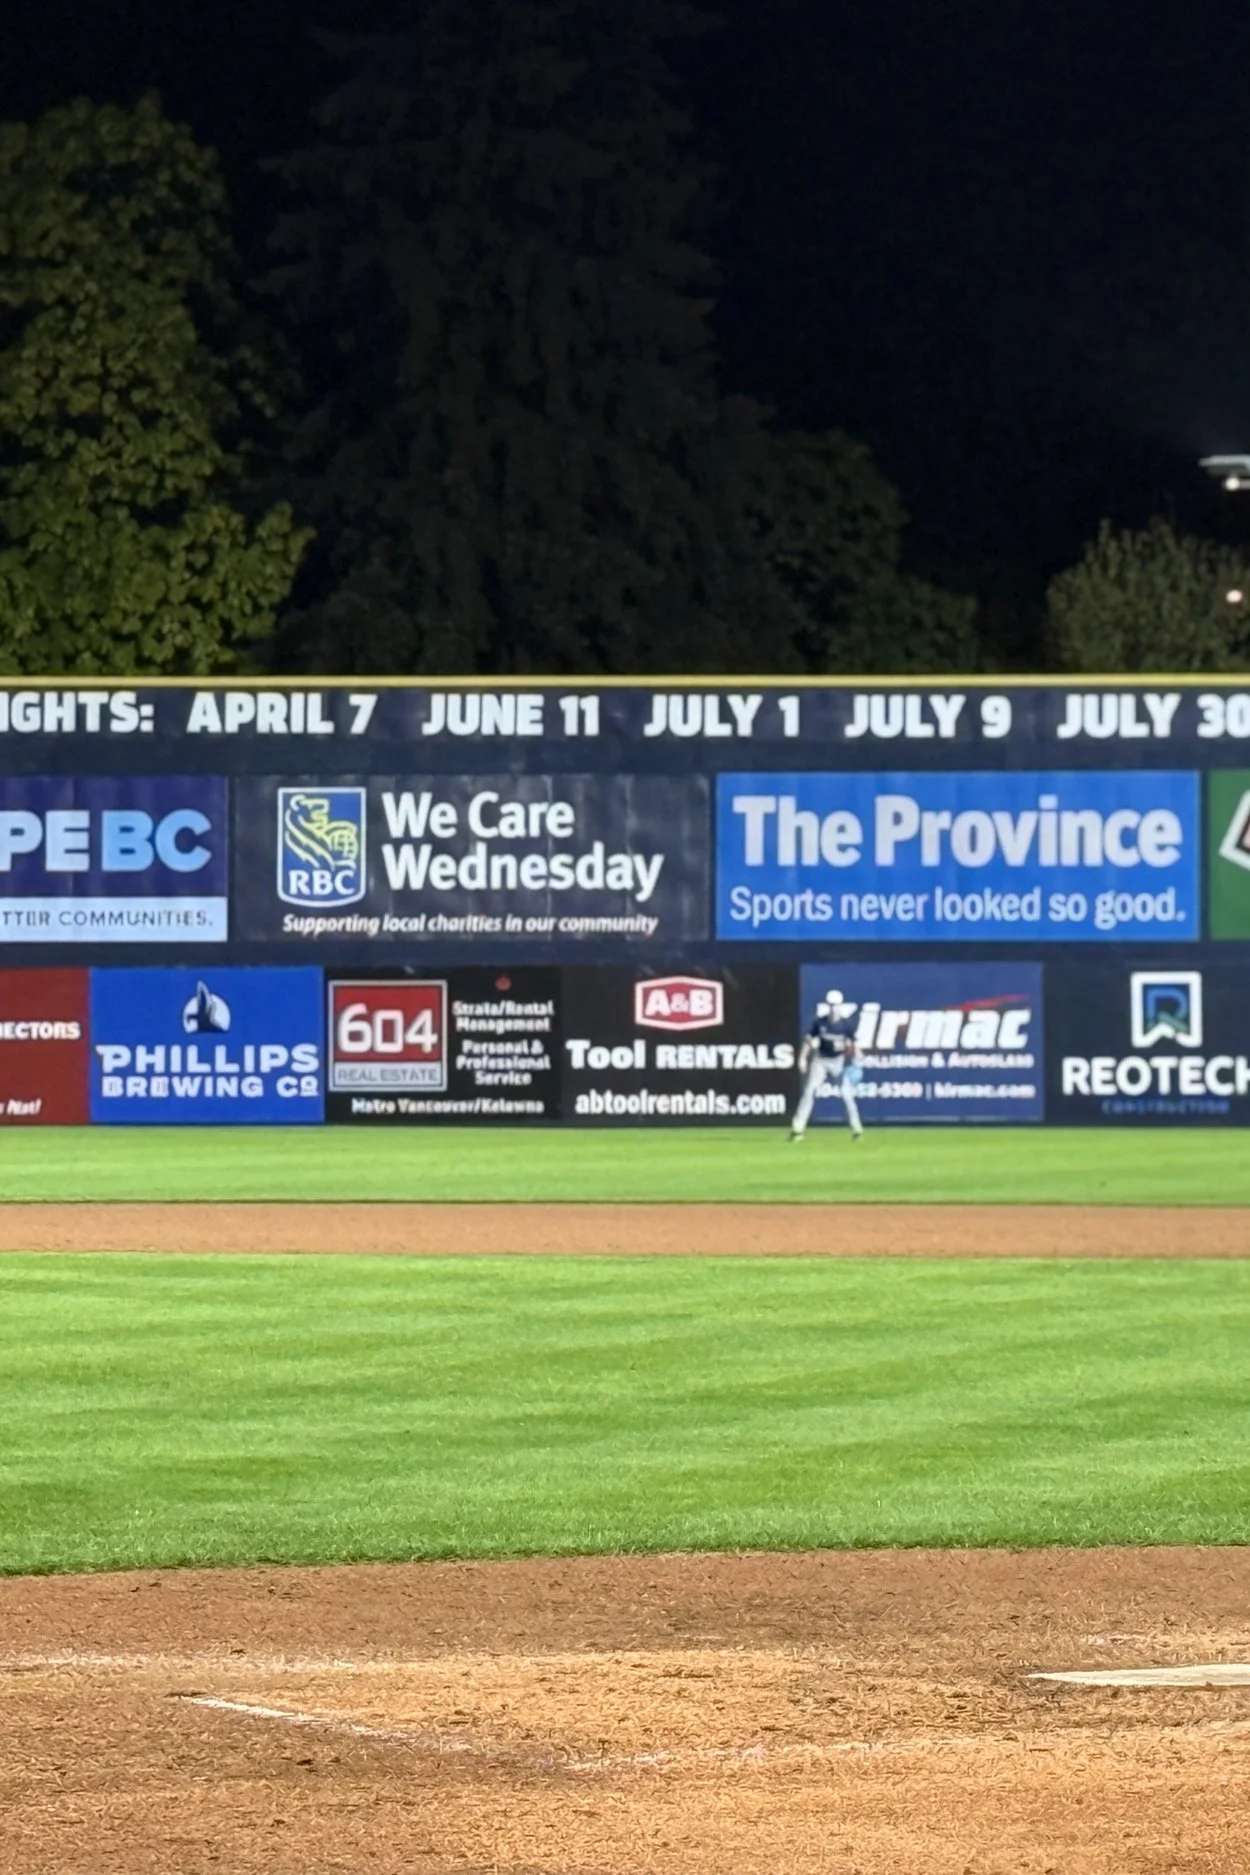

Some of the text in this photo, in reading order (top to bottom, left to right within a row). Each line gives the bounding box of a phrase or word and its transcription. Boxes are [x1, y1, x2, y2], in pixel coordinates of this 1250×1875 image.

[187, 691, 334, 734] APRIL
[350, 694, 378, 735] 7
[422, 695, 543, 736] JUNE
[560, 695, 600, 735] 11
[644, 694, 762, 737] JULY
[777, 695, 799, 736] 1
[845, 694, 965, 738] JULY
[981, 695, 1012, 738] 9
[1057, 693, 1181, 738] JULY
[381, 791, 574, 838] We Care
[102, 808, 212, 872] BC
[732, 794, 1183, 868] The Province
[288, 869, 356, 895] RBC
[381, 842, 664, 902] Wednesday
[58, 910, 214, 927] COMMUNITIES.
[730, 886, 1186, 930] Sports never looked so good.
[282, 914, 659, 937] Supporting local charities in our community
[645, 989, 714, 1016] A&B
[0, 1021, 80, 1039] ECTORS
[338, 1003, 438, 1053] 604
[456, 1017, 551, 1034] Management
[95, 1043, 319, 1073] PHILLIPS
[456, 1054, 551, 1070] Professional
[565, 1039, 795, 1069] Tool RENTALS
[931, 1052, 946, 1068] &
[102, 1076, 263, 1097] BREWING
[338, 1068, 439, 1082] REAL ESTATE
[475, 1070, 532, 1086] Service
[352, 1098, 395, 1114] Metro
[575, 1089, 786, 1114] abtoolrentals.com
